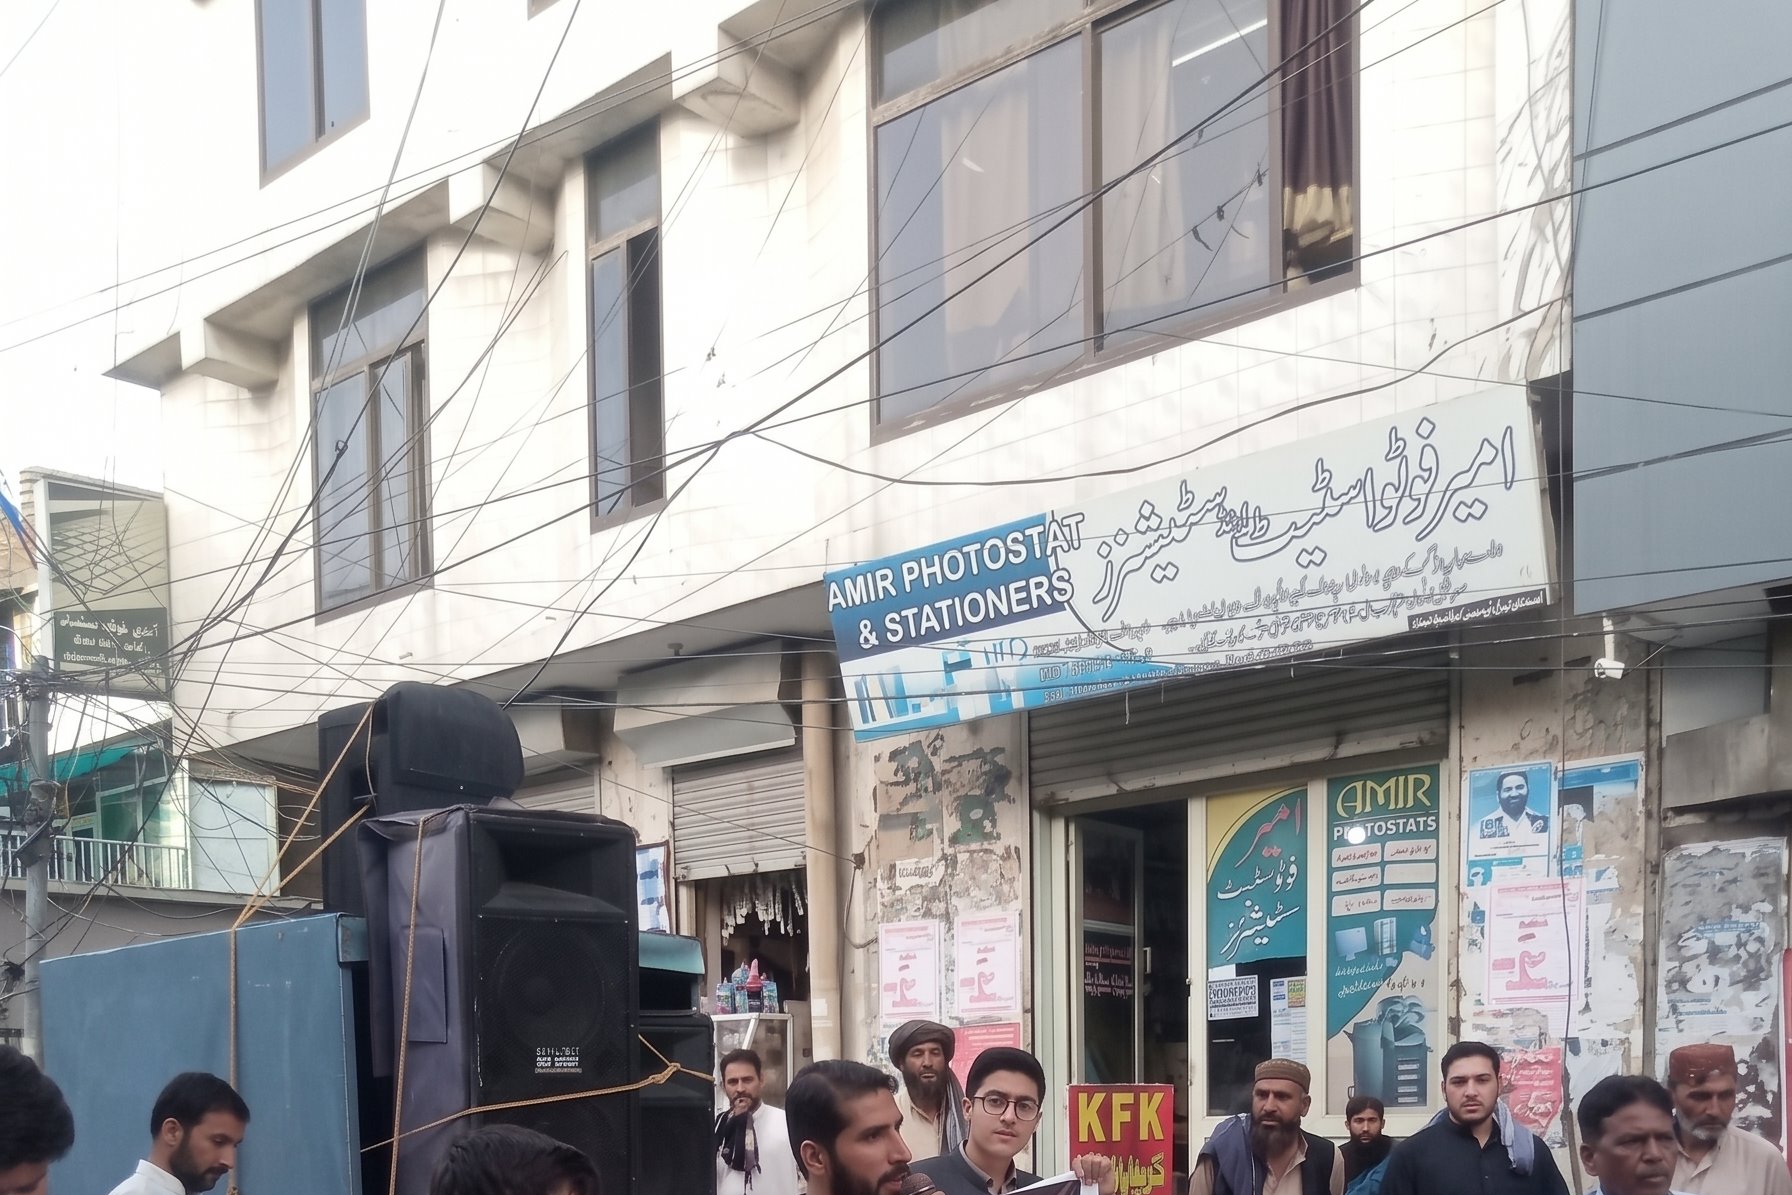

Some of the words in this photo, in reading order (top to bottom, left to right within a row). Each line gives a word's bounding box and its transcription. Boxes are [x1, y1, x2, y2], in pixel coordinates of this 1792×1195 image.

[1415, 425, 1515, 541] امیر
[827, 566, 898, 613] AMIR
[901, 512, 1085, 592] PHOTOSTAT
[858, 619, 879, 649] &
[884, 567, 1075, 643] STATIONERS
[1333, 816, 1437, 842] PTOSTATS
[1336, 773, 1432, 818] AMIR
[1235, 797, 1301, 868] امیر
[1078, 1092, 1165, 1142] KFK
